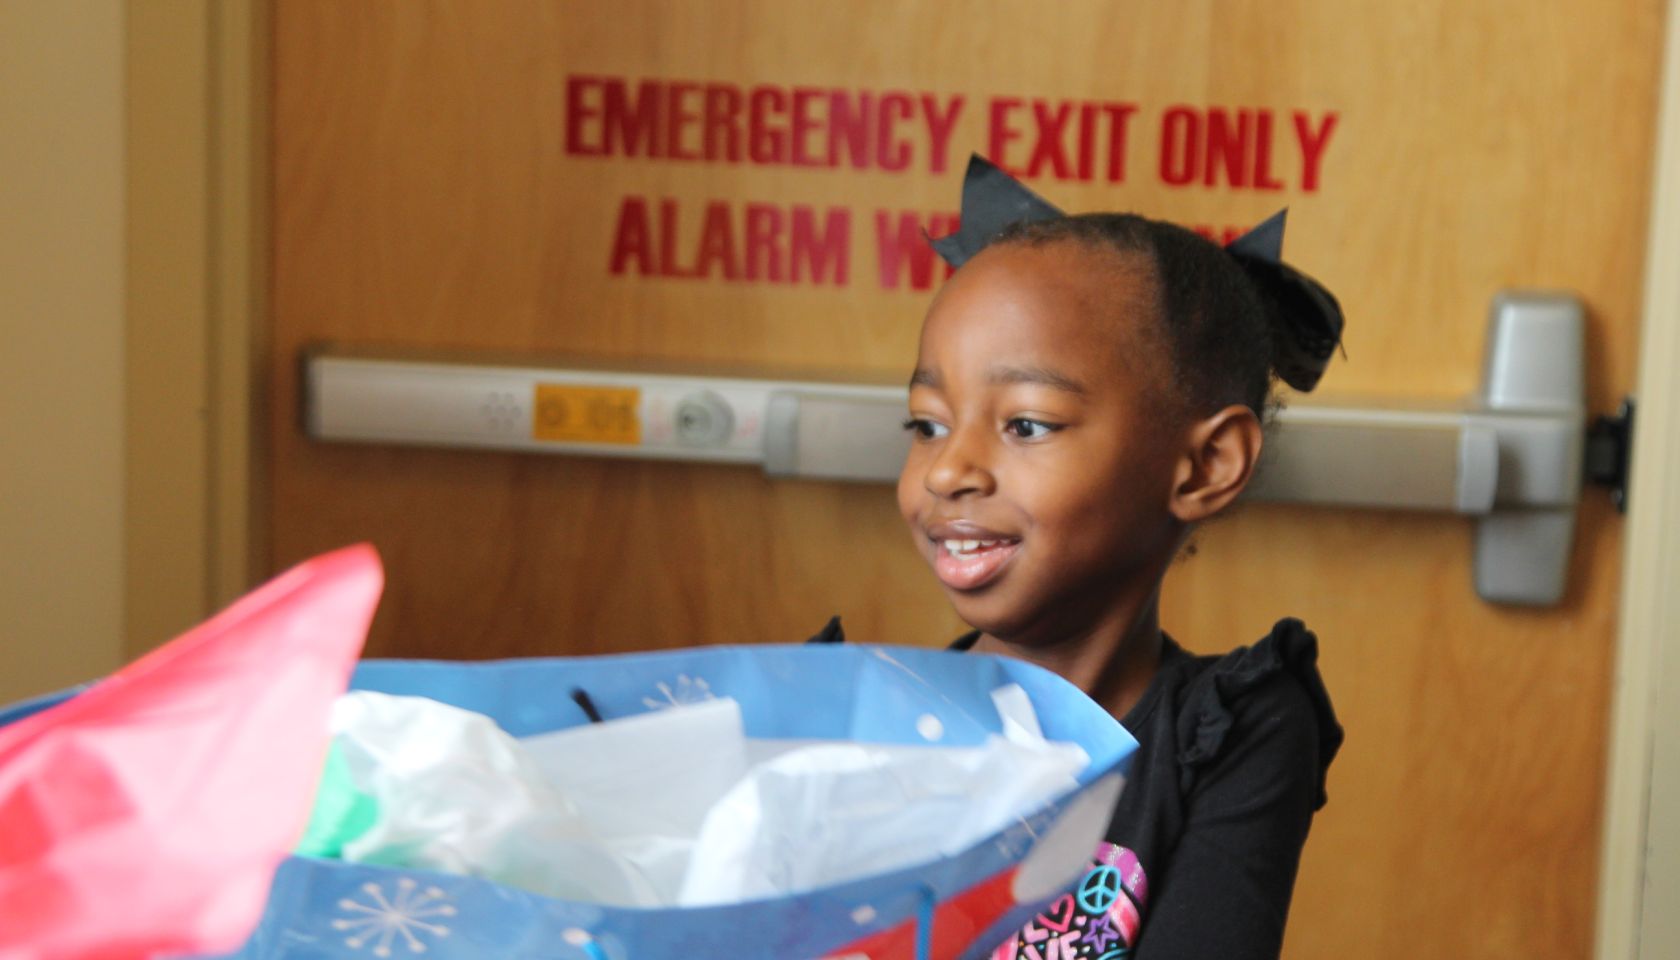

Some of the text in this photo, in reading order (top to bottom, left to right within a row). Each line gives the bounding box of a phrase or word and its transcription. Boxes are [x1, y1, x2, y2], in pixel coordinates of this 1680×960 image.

[563, 74, 1338, 192] EMERGENCY EXIT ONLY
[608, 196, 852, 287] ALARM
